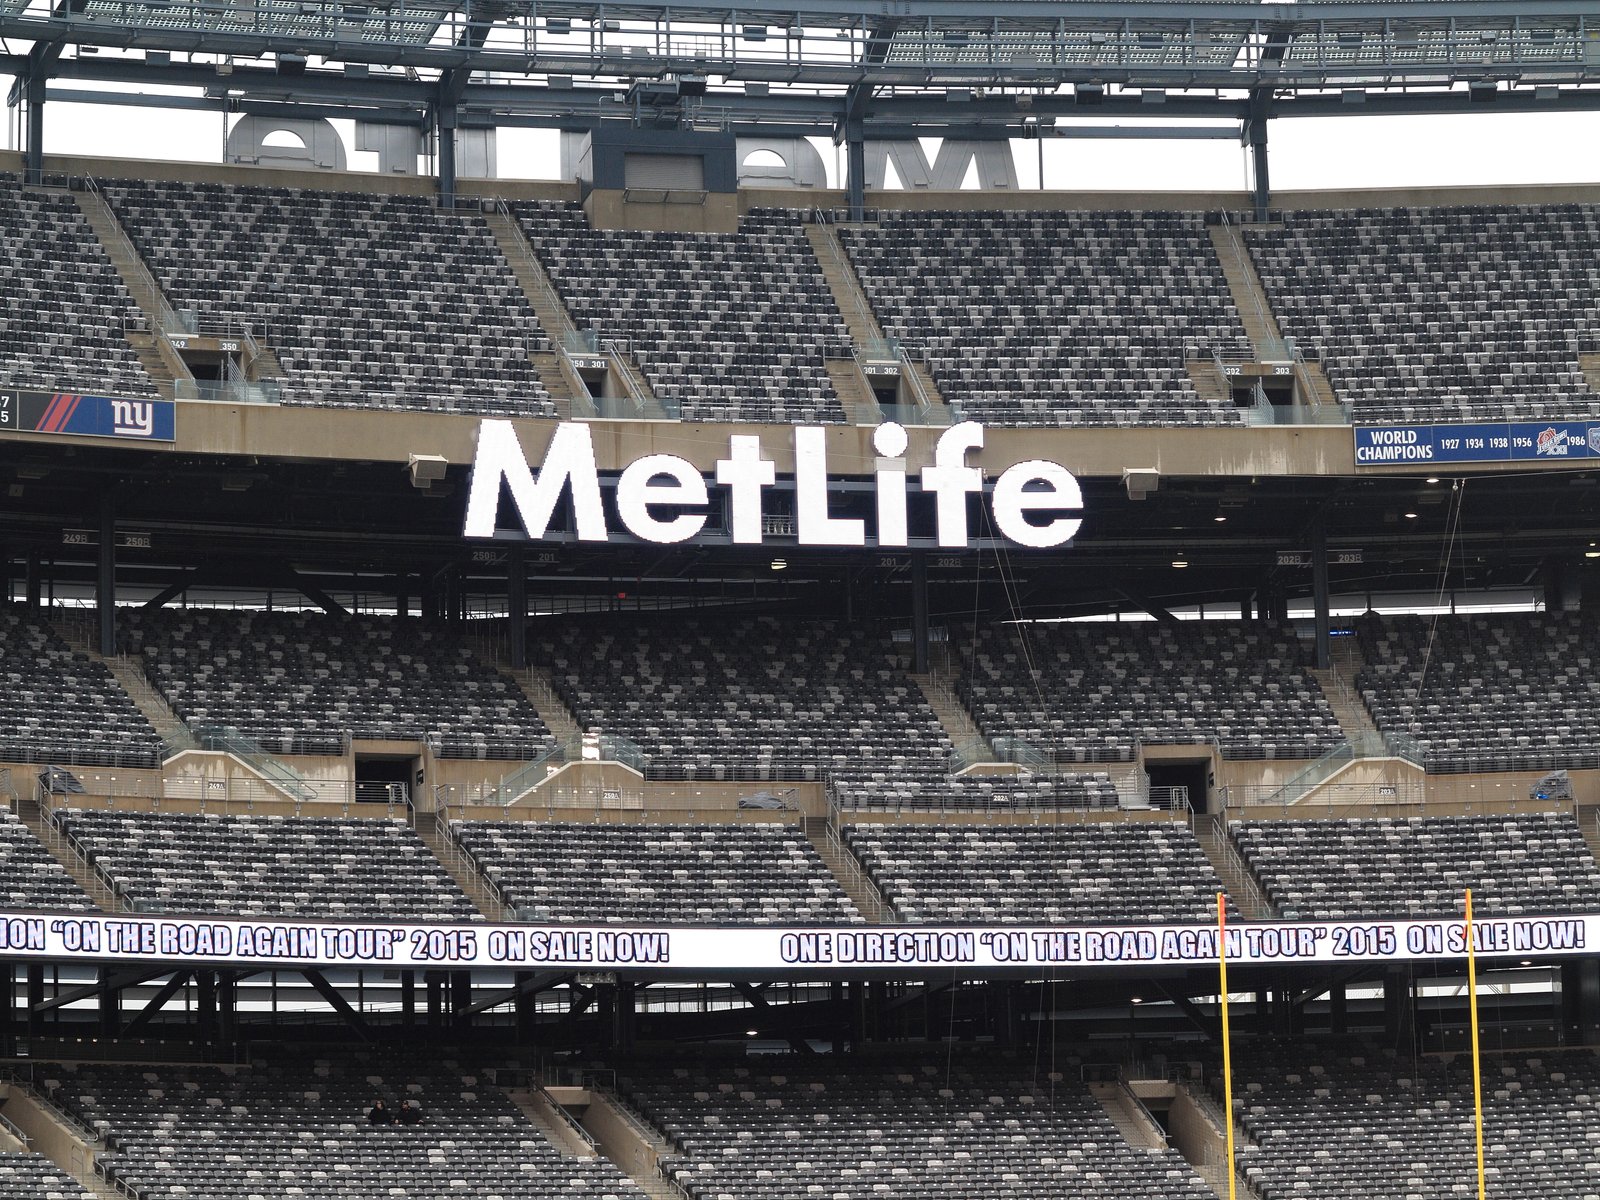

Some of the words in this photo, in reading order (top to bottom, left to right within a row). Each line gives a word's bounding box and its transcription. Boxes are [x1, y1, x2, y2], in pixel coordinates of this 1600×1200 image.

[222, 342, 237, 350] 350
[592, 360, 605, 368] 301
[884, 367, 898, 375] 302
[1275, 367, 1290, 375] 303
[1370, 430, 1418, 445] WORLD
[1441, 438, 1460, 449] 1927
[1465, 438, 1484, 449] 1934
[1489, 437, 1508, 448] 1938
[1513, 437, 1532, 448] 1956
[1566, 436, 1586, 446] 1986
[1357, 445, 1433, 460] CHAMPIONS
[463, 419, 1084, 548] MetLife
[63, 534, 88, 543] 249B
[126, 537, 150, 546] 250B
[539, 553, 555, 561] 201
[1338, 554, 1362, 563] 203B
[105, 921, 155, 954] THE
[160, 923, 232, 956] ROAD
[237, 926, 318, 959] AGAIN
[411, 929, 478, 961] 2015
[488, 930, 526, 961] ON
[530, 931, 592, 962] SALE
[597, 932, 670, 963] NOW!
[780, 932, 833, 963] ONE
[837, 932, 975, 963] DIRECTION
[1032, 931, 1081, 962] THE
[1087, 930, 1156, 962] ROAD
[1160, 929, 1242, 960] AGAIN
[1332, 926, 1397, 957] 2015
[1407, 924, 1443, 954] ON
[1447, 922, 1510, 953] SALE
[1513, 919, 1585, 951] NOW!
